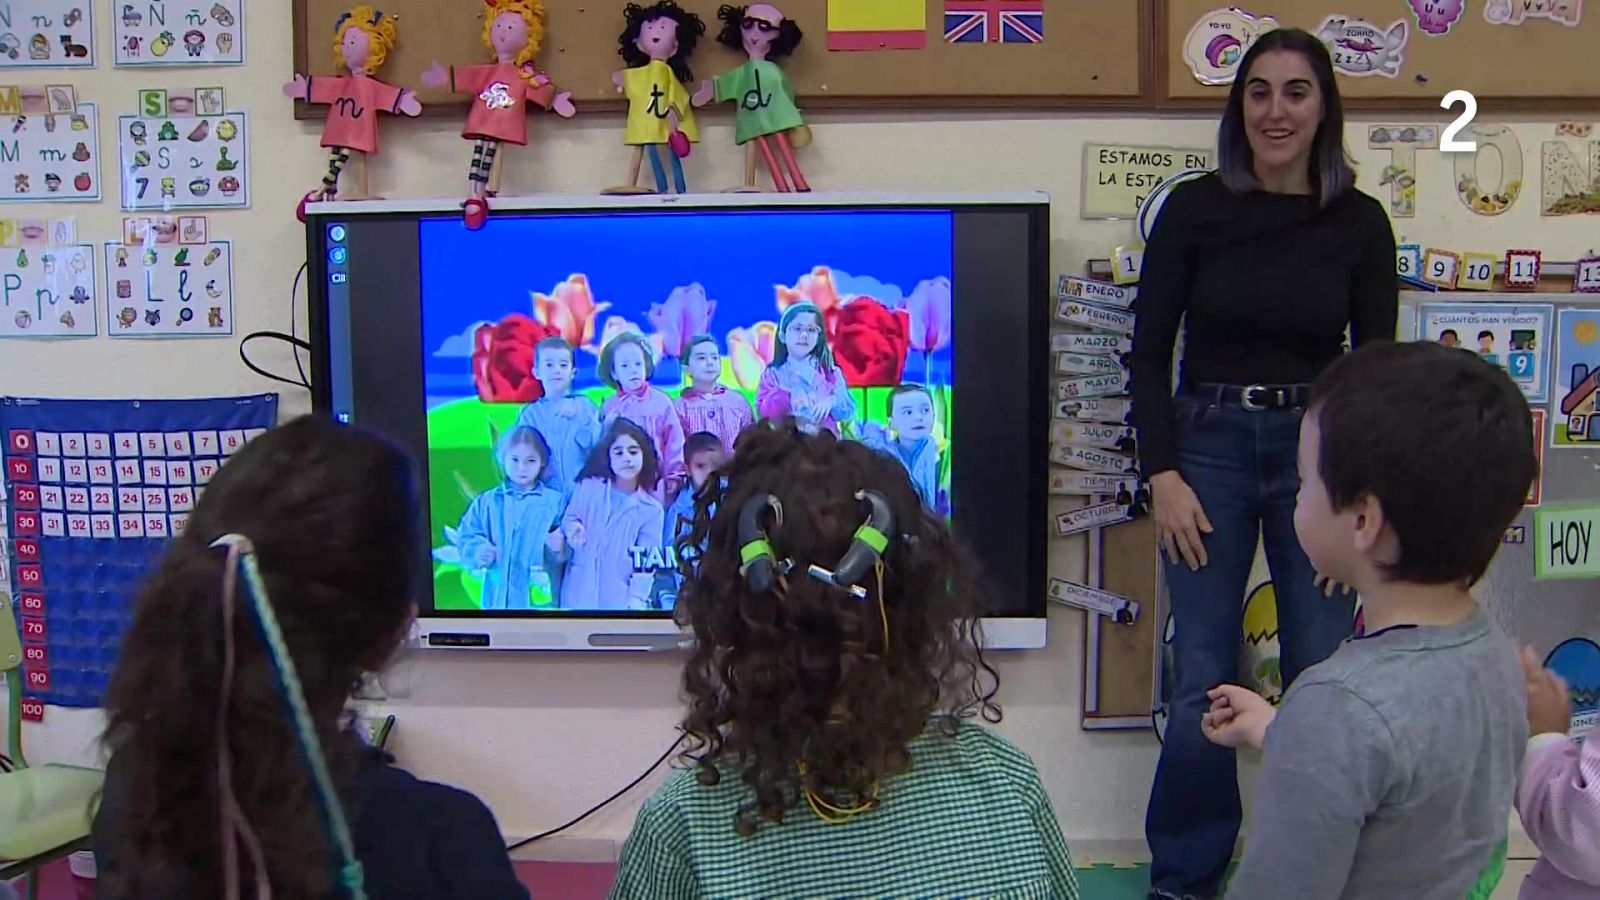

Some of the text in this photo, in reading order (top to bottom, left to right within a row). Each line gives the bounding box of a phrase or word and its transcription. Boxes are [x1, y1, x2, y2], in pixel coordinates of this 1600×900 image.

[31, 15, 52, 27] n
[185, 9, 206, 26] ñ
[1346, 29, 1374, 38] ZORRO
[741, 69, 772, 111] d
[145, 91, 161, 115] S
[335, 97, 364, 119] n
[647, 84, 669, 118] t
[0, 140, 66, 162] M m
[158, 146, 170, 169] S
[1100, 149, 1206, 169] ESTAMOS EN
[1098, 171, 1117, 186] LA
[135, 177, 149, 199] 7
[1126, 256, 1136, 272] 1
[1398, 256, 1409, 272] 8
[1433, 261, 1445, 277] 9
[1467, 264, 1490, 280] 10
[1514, 261, 1534, 277] 11
[147, 270, 164, 301] L
[1086, 284, 1124, 299] ENERO
[4, 274, 60, 320] P p
[1081, 307, 1126, 325] FEBRERO
[1074, 337, 1119, 347] MARZO
[1516, 355, 1527, 373] 9
[1085, 376, 1119, 388] MAYO
[1081, 428, 1113, 438] JULIO
[45, 440, 51, 449] 1
[69, 440, 77, 449] 2
[94, 440, 102, 449] 3
[122, 440, 131, 449] 4
[148, 440, 157, 449] 5
[174, 440, 182, 450] 6
[202, 437, 209, 447] 7
[228, 437, 236, 447] 8
[1076, 450, 1122, 470] AGOSTO
[15, 463, 212, 478] 10 11 12 13 14 15 16 17
[19, 491, 189, 504] 20 21 22 23 24 25 26
[19, 517, 35, 528] 30
[48, 519, 59, 529] 31
[72, 520, 86, 530] 32
[96, 520, 110, 530] 33
[123, 520, 138, 530] 34
[149, 519, 163, 530] 35
[20, 544, 36, 555] 40
[1550, 519, 1591, 567] HOY
[23, 571, 39, 581] 50
[28, 623, 43, 634] 70
[27, 650, 43, 660] 80
[30, 673, 47, 684] 90
[22, 703, 43, 715] 100
